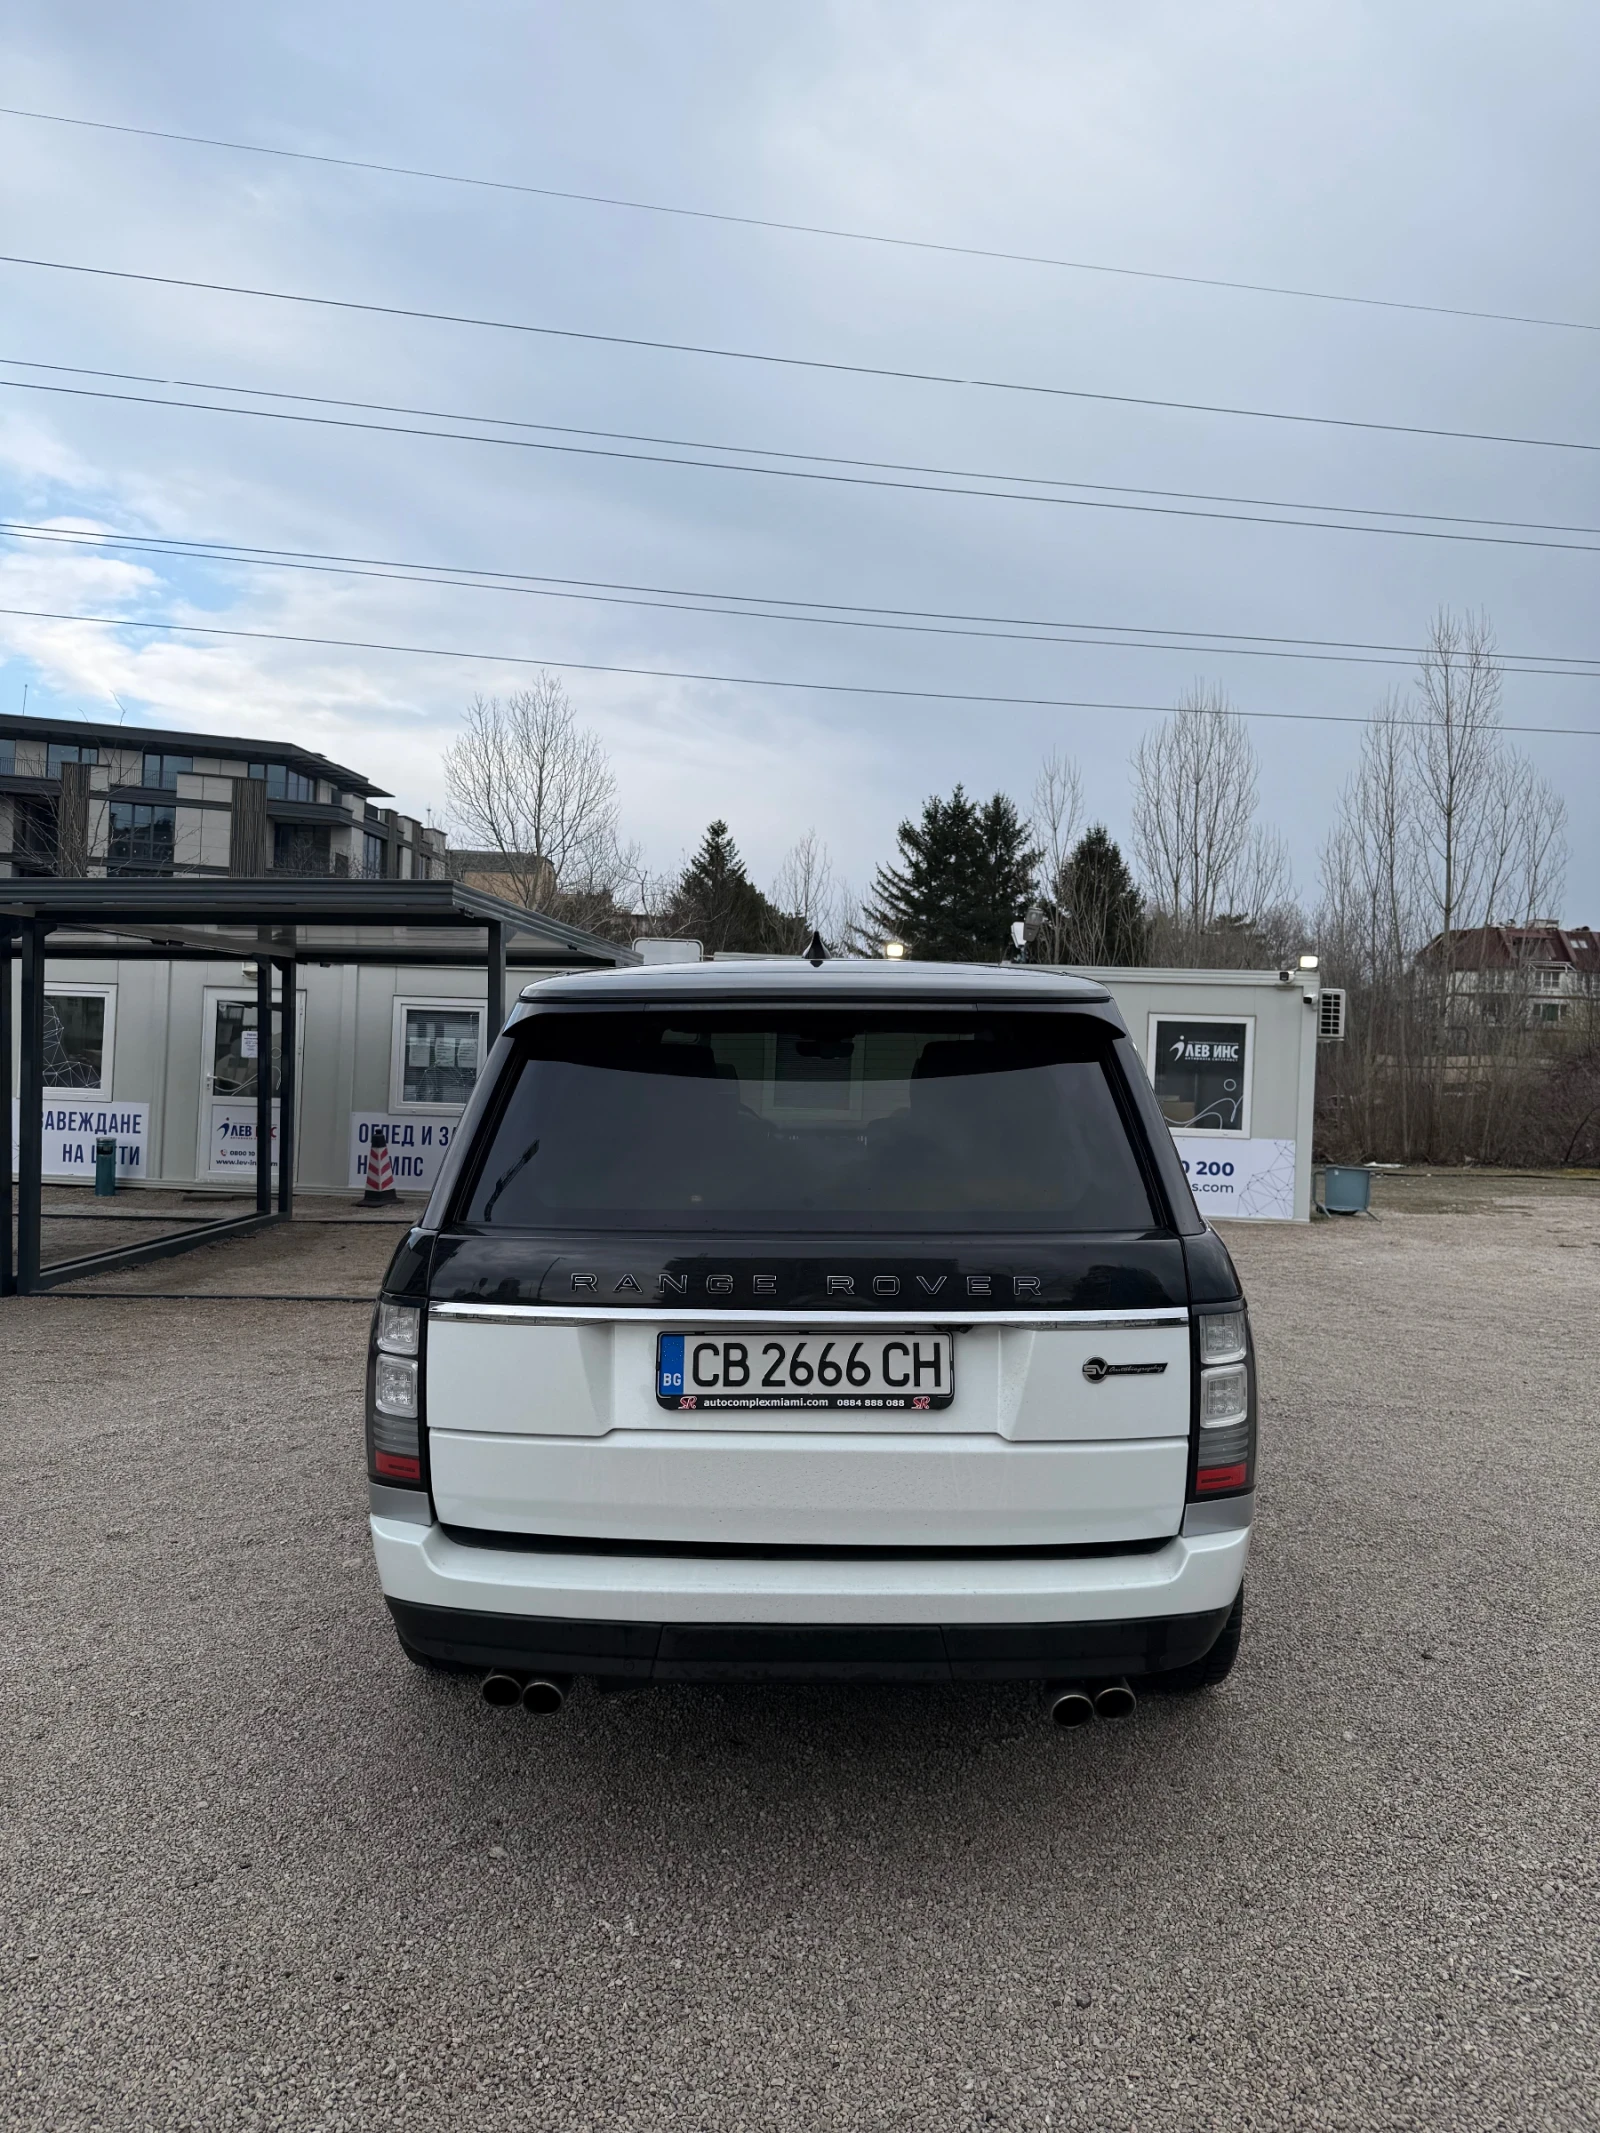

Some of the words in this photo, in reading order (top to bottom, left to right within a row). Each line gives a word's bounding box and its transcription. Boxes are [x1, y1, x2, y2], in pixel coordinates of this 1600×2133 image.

[1184, 1043, 1210, 1057] ЛЕВ
[1213, 1045, 1239, 1059] ИНС
[41, 1110, 142, 1135] АВЕЖДАНЕ
[230, 1125, 252, 1137] ЛЕВ
[421, 1126, 433, 1146] И
[62, 1143, 84, 1163] НА
[91, 1145, 140, 1166] ТИ
[389, 1155, 424, 1177] МПС
[1195, 1161, 1235, 1177] 200
[570, 1273, 778, 1294] RANGE
[826, 1275, 1043, 1296] ROVER
[761, 1342, 871, 1387] 2666
[1083, 1364, 1108, 1375] SV
[662, 1373, 682, 1387] BG
[703, 1397, 829, 1409] autocomplexmiami.com
[836, 1398, 862, 1407] 0884
[864, 1399, 884, 1407] 888
[885, 1399, 905, 1408] 088
